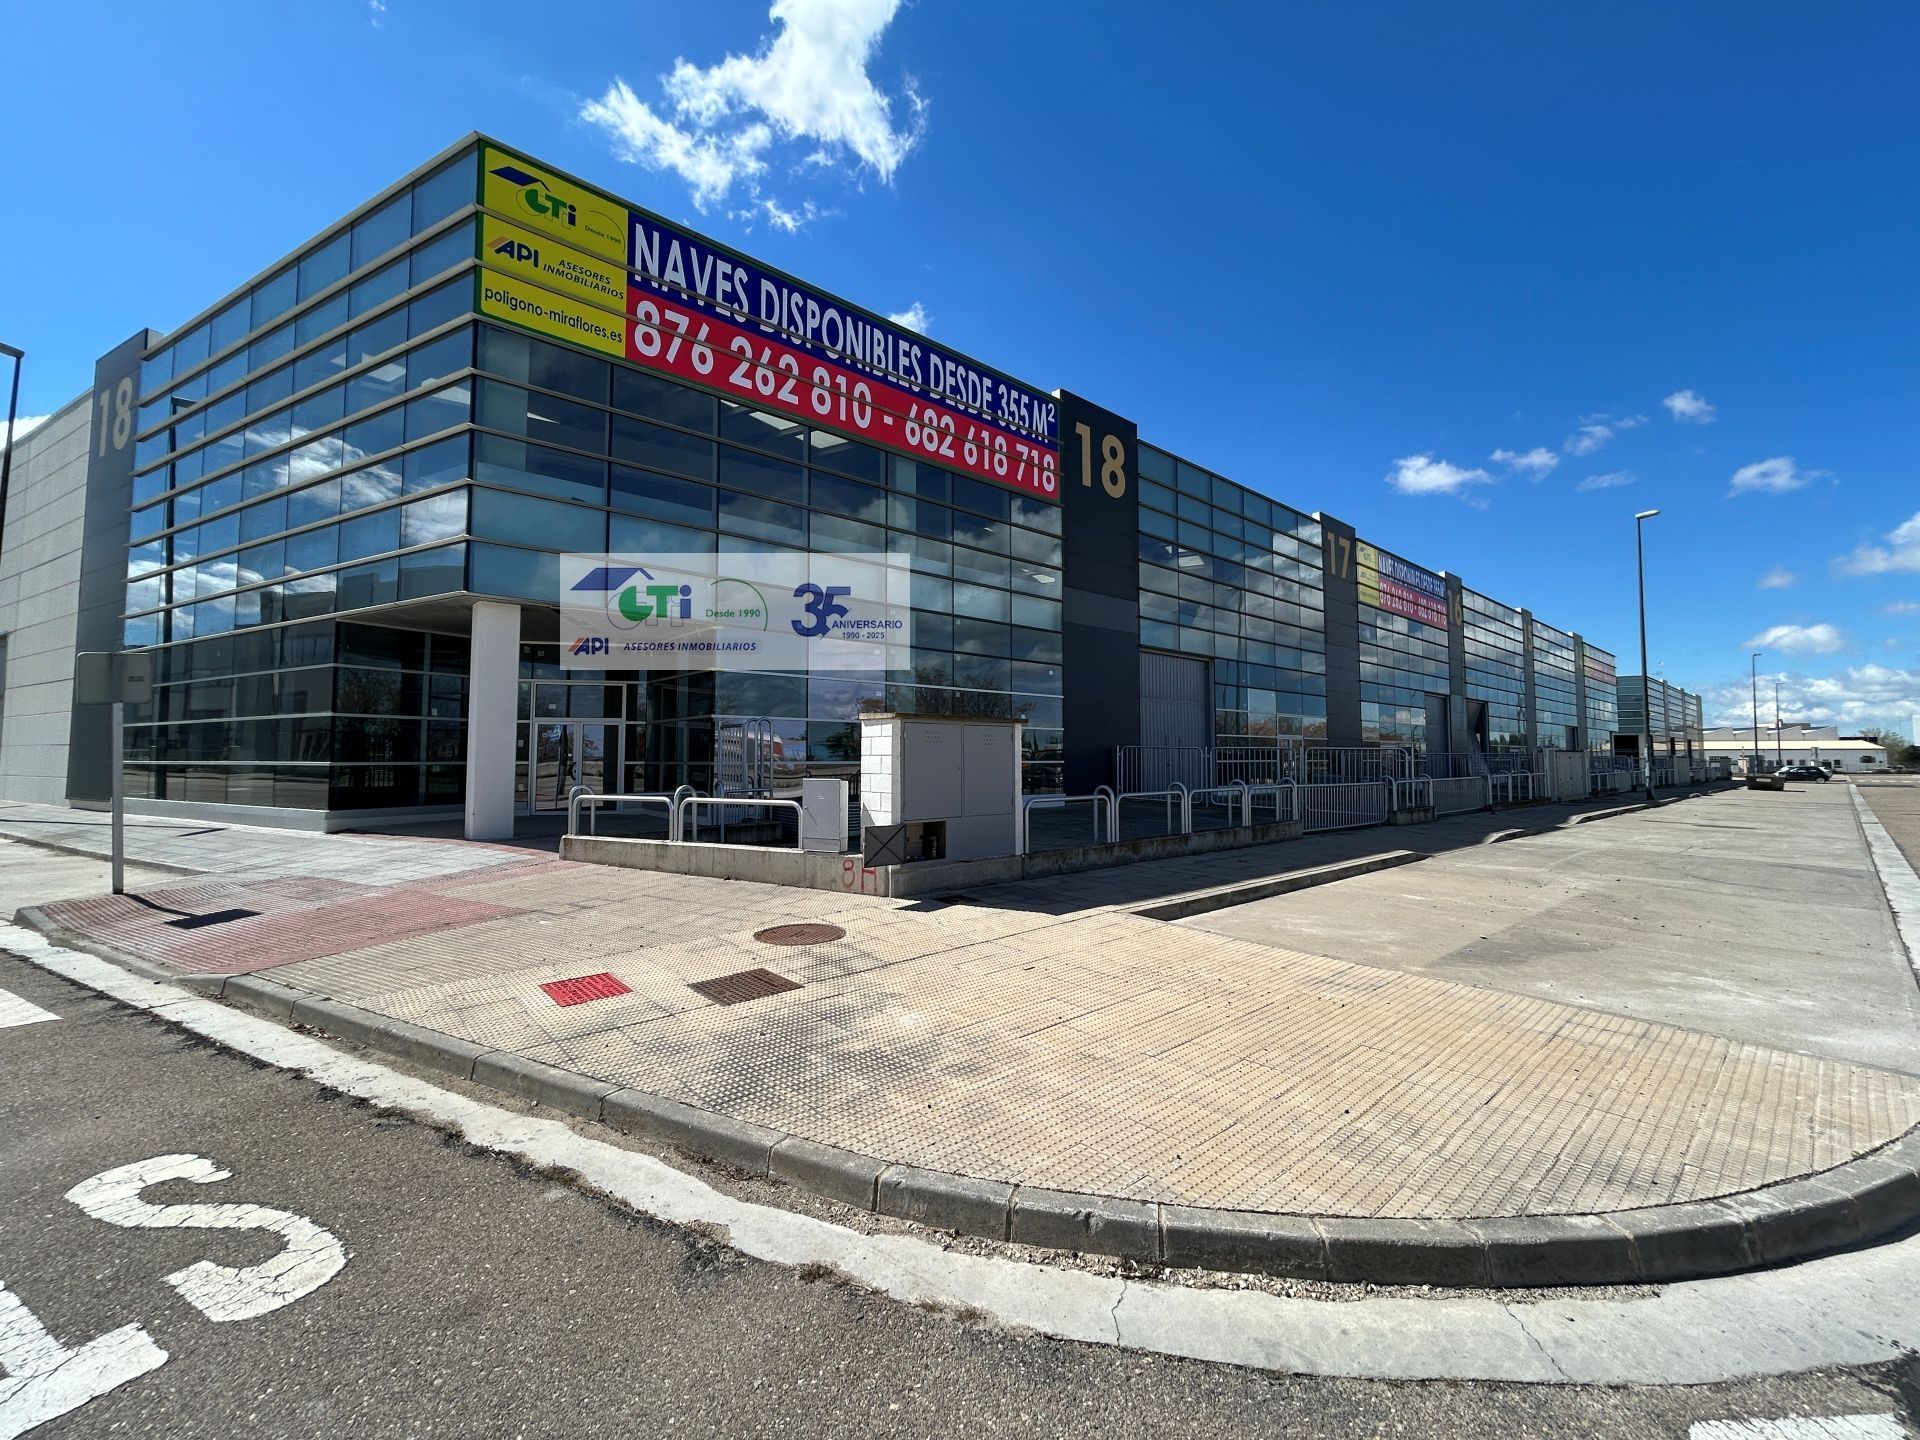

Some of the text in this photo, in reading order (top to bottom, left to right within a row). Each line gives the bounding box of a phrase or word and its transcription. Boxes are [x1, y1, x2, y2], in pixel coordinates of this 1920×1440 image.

[493, 239, 540, 269] API
[584, 223, 622, 245] Desde 1990
[542, 262, 625, 301] INMOBILIARIOS
[557, 258, 612, 286] ASESORES
[484, 286, 623, 344] poligono-miraflores.es
[634, 222, 749, 323] NAVES
[759, 277, 922, 393] DISPONIBLES
[929, 353, 992, 421] DESDE
[997, 383, 1029, 436] 355
[98, 376, 134, 458] 18
[634, 300, 714, 375] 876
[728, 335, 799, 406] 262
[811, 366, 872, 429] 810
[905, 402, 955, 459] 682
[963, 425, 1008, 476] 618
[1015, 443, 1056, 493] 718
[1074, 420, 1127, 499] 18
[1326, 531, 1351, 580] 17
[1447, 588, 1463, 626] 16
